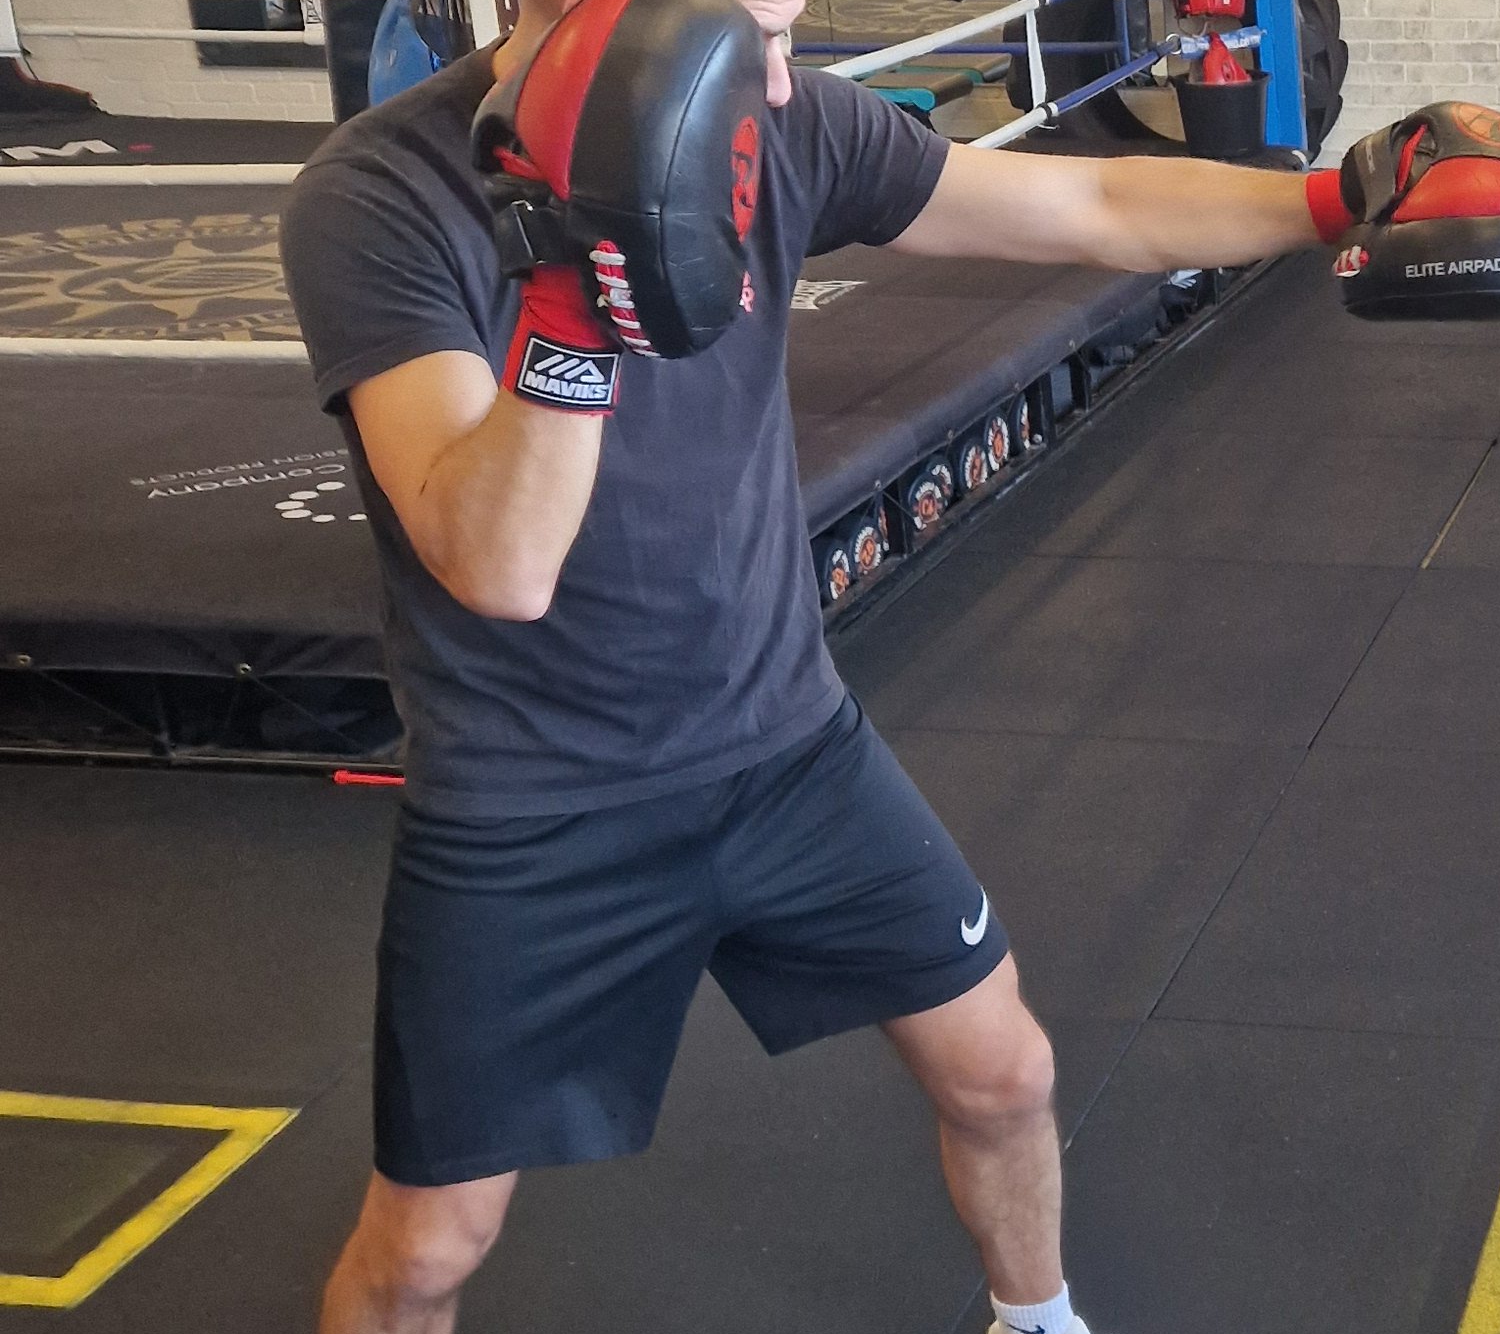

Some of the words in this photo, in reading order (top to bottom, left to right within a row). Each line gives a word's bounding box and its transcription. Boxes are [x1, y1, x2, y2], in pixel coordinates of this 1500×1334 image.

[1405, 260, 1446, 278] ELITE
[523, 370, 612, 399] MAVIKS
[147, 463, 346, 499] Company
